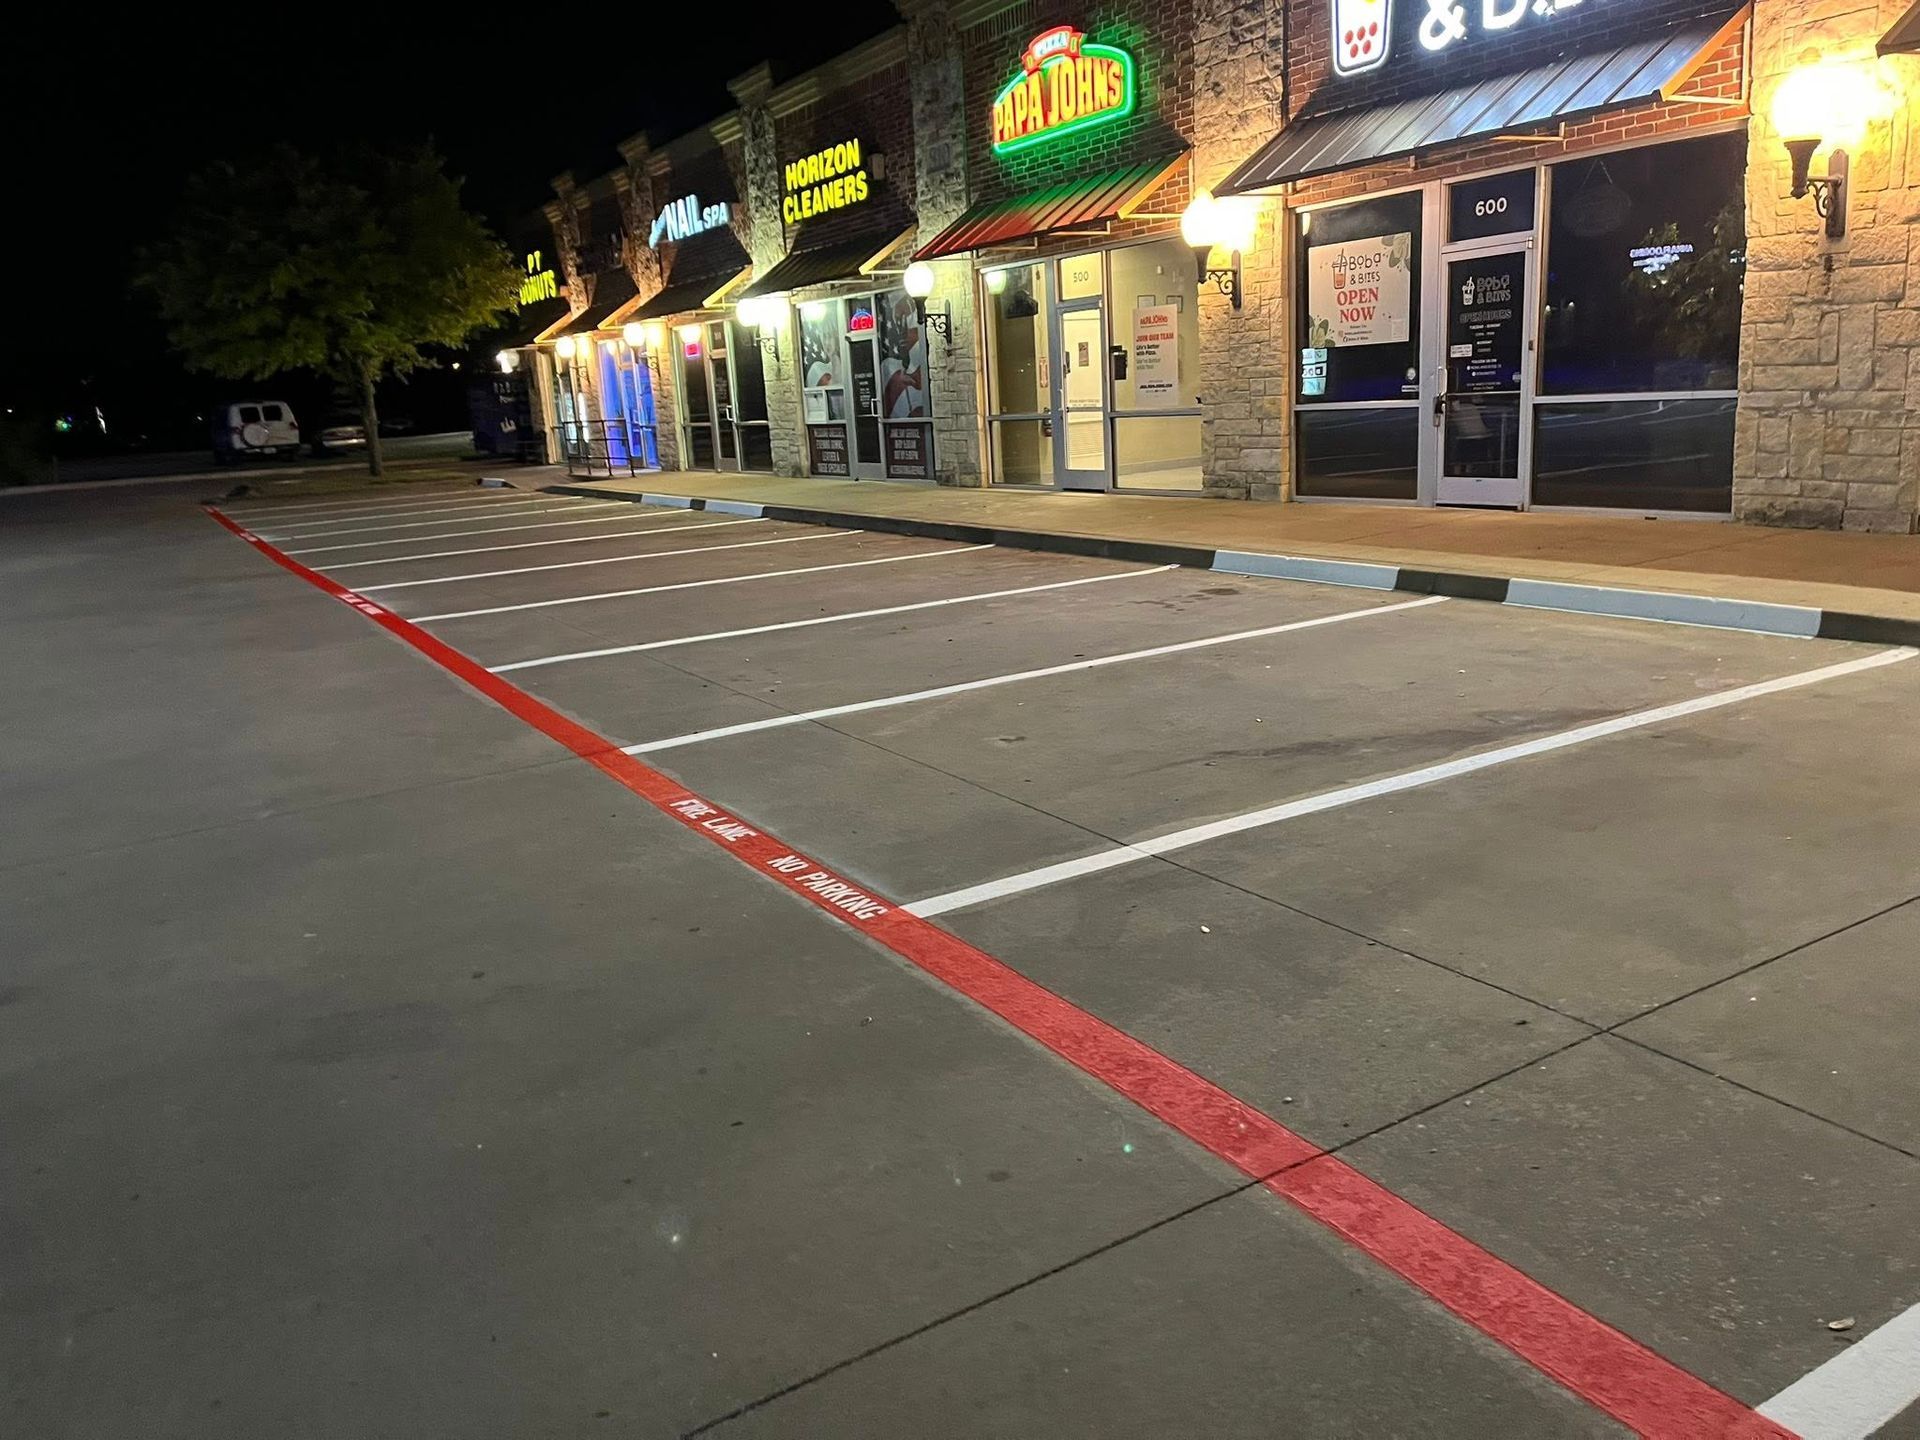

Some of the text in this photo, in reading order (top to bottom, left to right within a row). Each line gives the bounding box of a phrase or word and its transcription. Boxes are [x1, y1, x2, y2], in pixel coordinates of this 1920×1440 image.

[993, 57, 1122, 143] PAPA JOHNS
[785, 137, 860, 191] HORIZON
[664, 193, 729, 242] NAIL SPA
[782, 170, 868, 224] CLEANERS
[1475, 197, 1507, 216] 600
[1073, 270, 1089, 283] 500
[1336, 287, 1380, 306] OPEN
[1349, 271, 1381, 285] & BITES
[1339, 305, 1377, 323] NOW
[669, 798, 757, 842] FIRE LANE
[766, 855, 889, 920] NO PARKING
